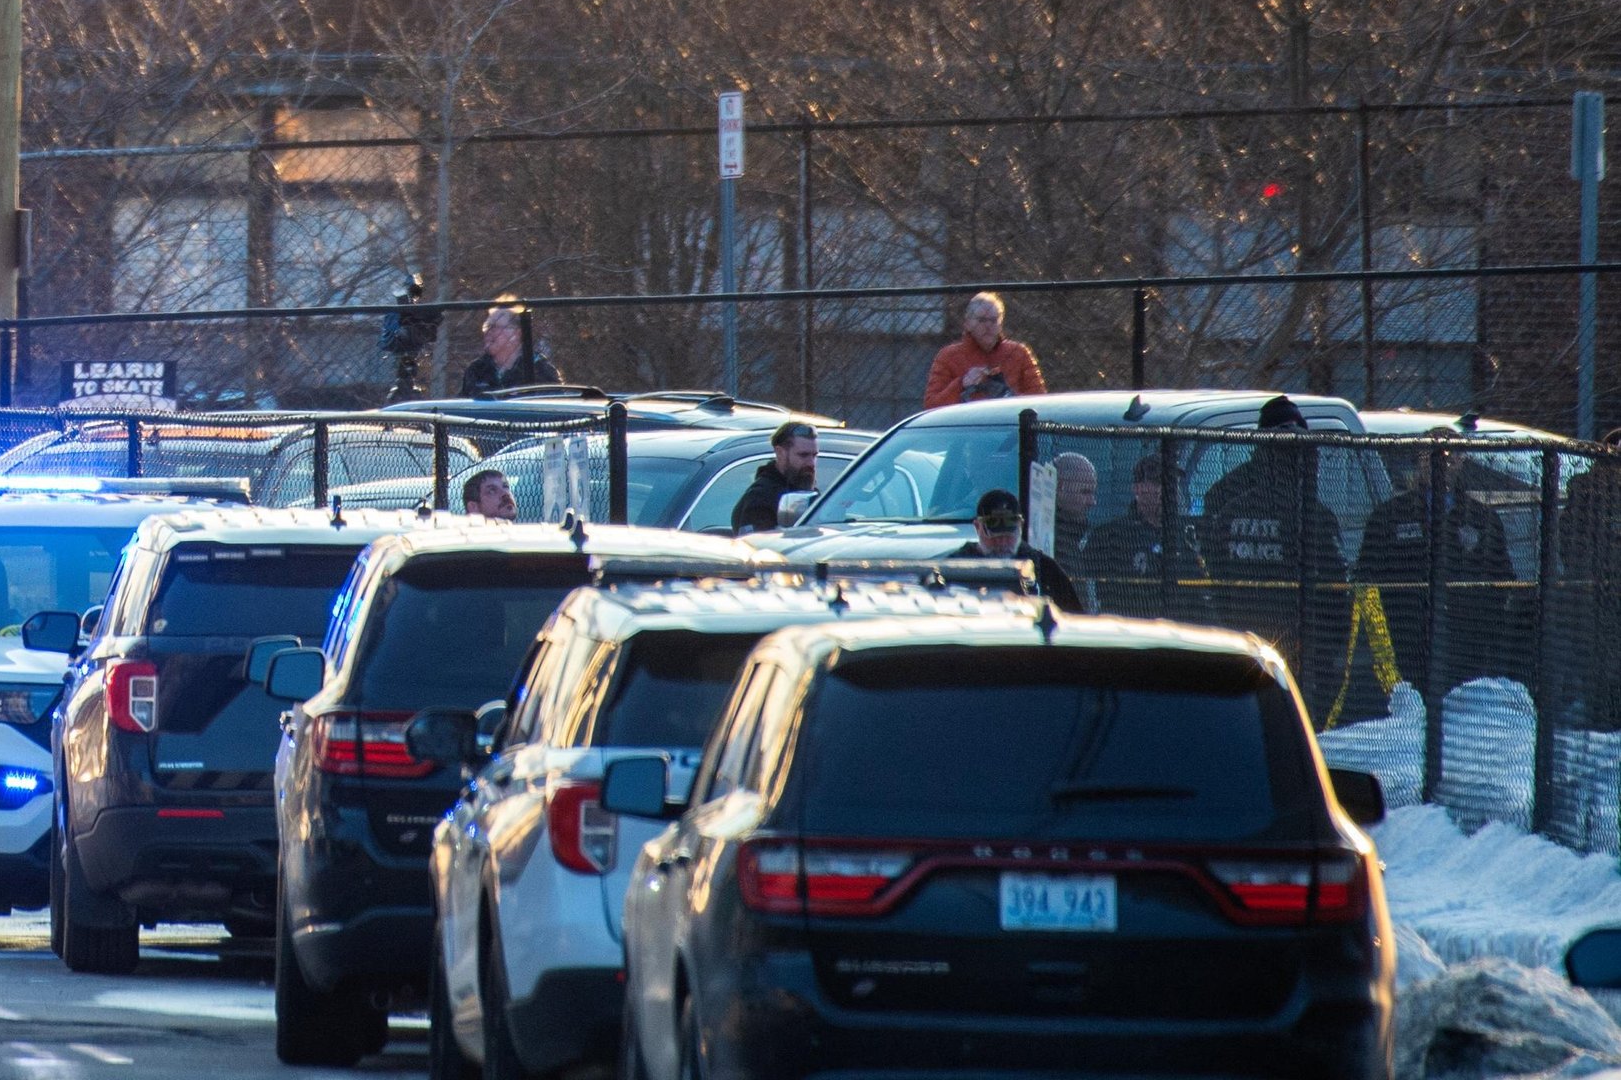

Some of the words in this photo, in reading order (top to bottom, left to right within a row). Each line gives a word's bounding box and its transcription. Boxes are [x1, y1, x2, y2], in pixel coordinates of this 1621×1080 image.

[73, 362, 165, 379] LEARN
[72, 380, 98, 397] TO
[102, 380, 165, 396] SKATE
